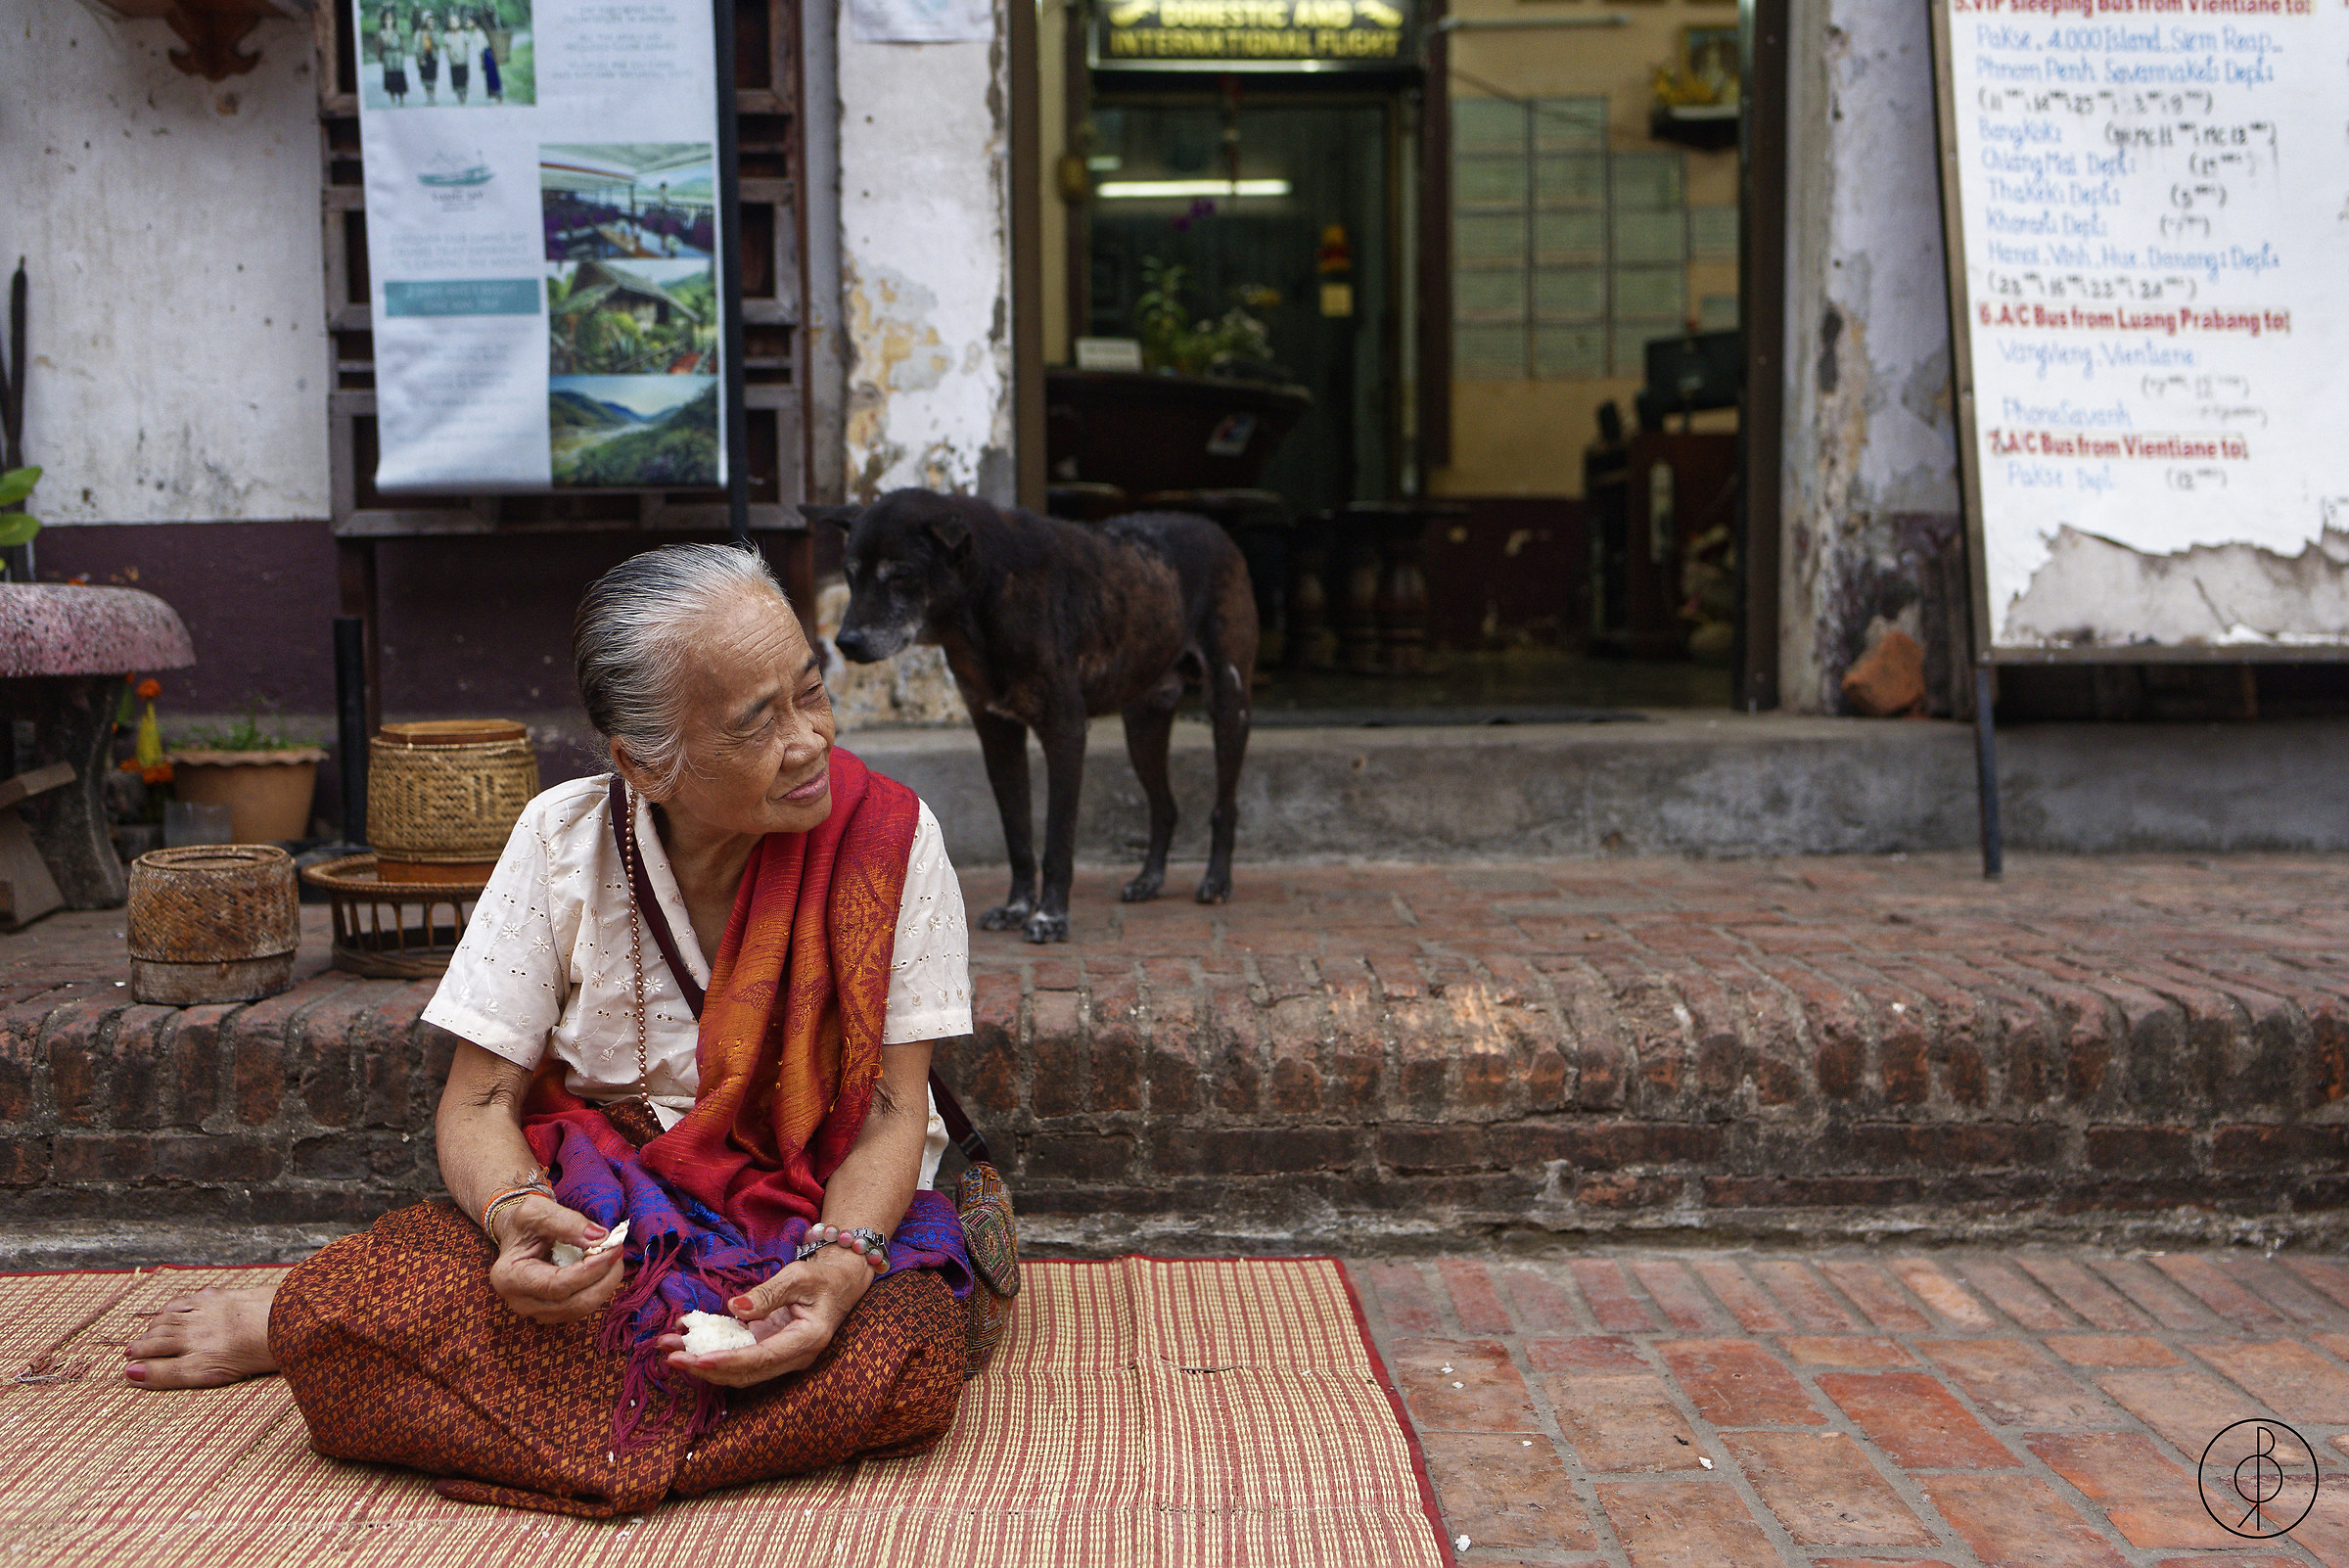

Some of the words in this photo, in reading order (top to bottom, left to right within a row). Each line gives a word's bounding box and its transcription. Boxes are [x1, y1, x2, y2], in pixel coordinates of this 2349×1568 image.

[2071, 304, 2115, 330] from
[2117, 305, 2178, 337] Luang
[2179, 306, 2261, 338] Prabang
[2077, 433, 2121, 458] from
[2122, 434, 2217, 460] Vientiane
